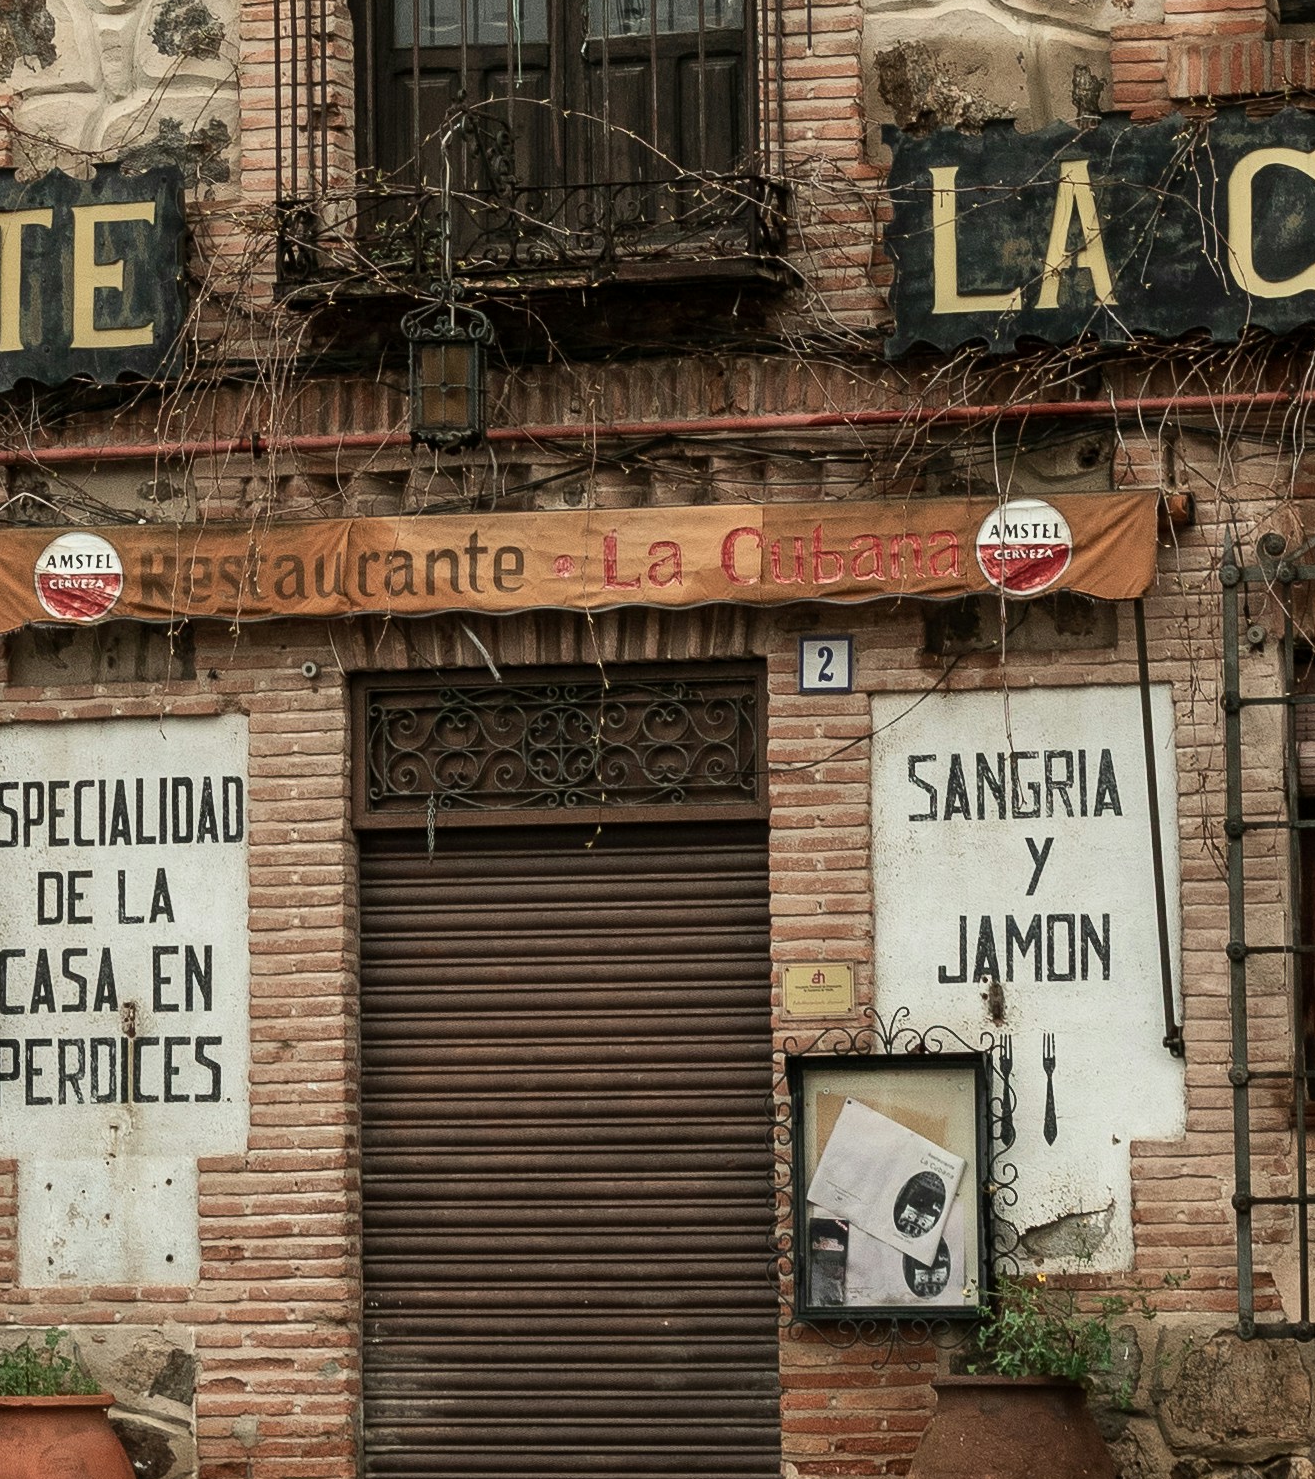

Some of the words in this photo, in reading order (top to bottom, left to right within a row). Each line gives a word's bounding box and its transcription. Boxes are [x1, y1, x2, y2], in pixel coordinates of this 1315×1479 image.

[928, 159, 1119, 314] LA
[988, 523, 1062, 539] AMSTEL
[993, 548, 1054, 560] CERVEZA
[45, 553, 114, 569] AMSTEL
[49, 579, 105, 590] CERVEZA
[140, 530, 525, 604] Restaurante
[601, 528, 684, 591] La
[720, 523, 965, 587] Cubana
[818, 645, 835, 682] 2
[907, 748, 1123, 822] SANGRIA
[36, 869, 94, 926] DE
[117, 868, 175, 924] LA
[938, 913, 1112, 984] JAMON
[151, 944, 214, 1013] EN
